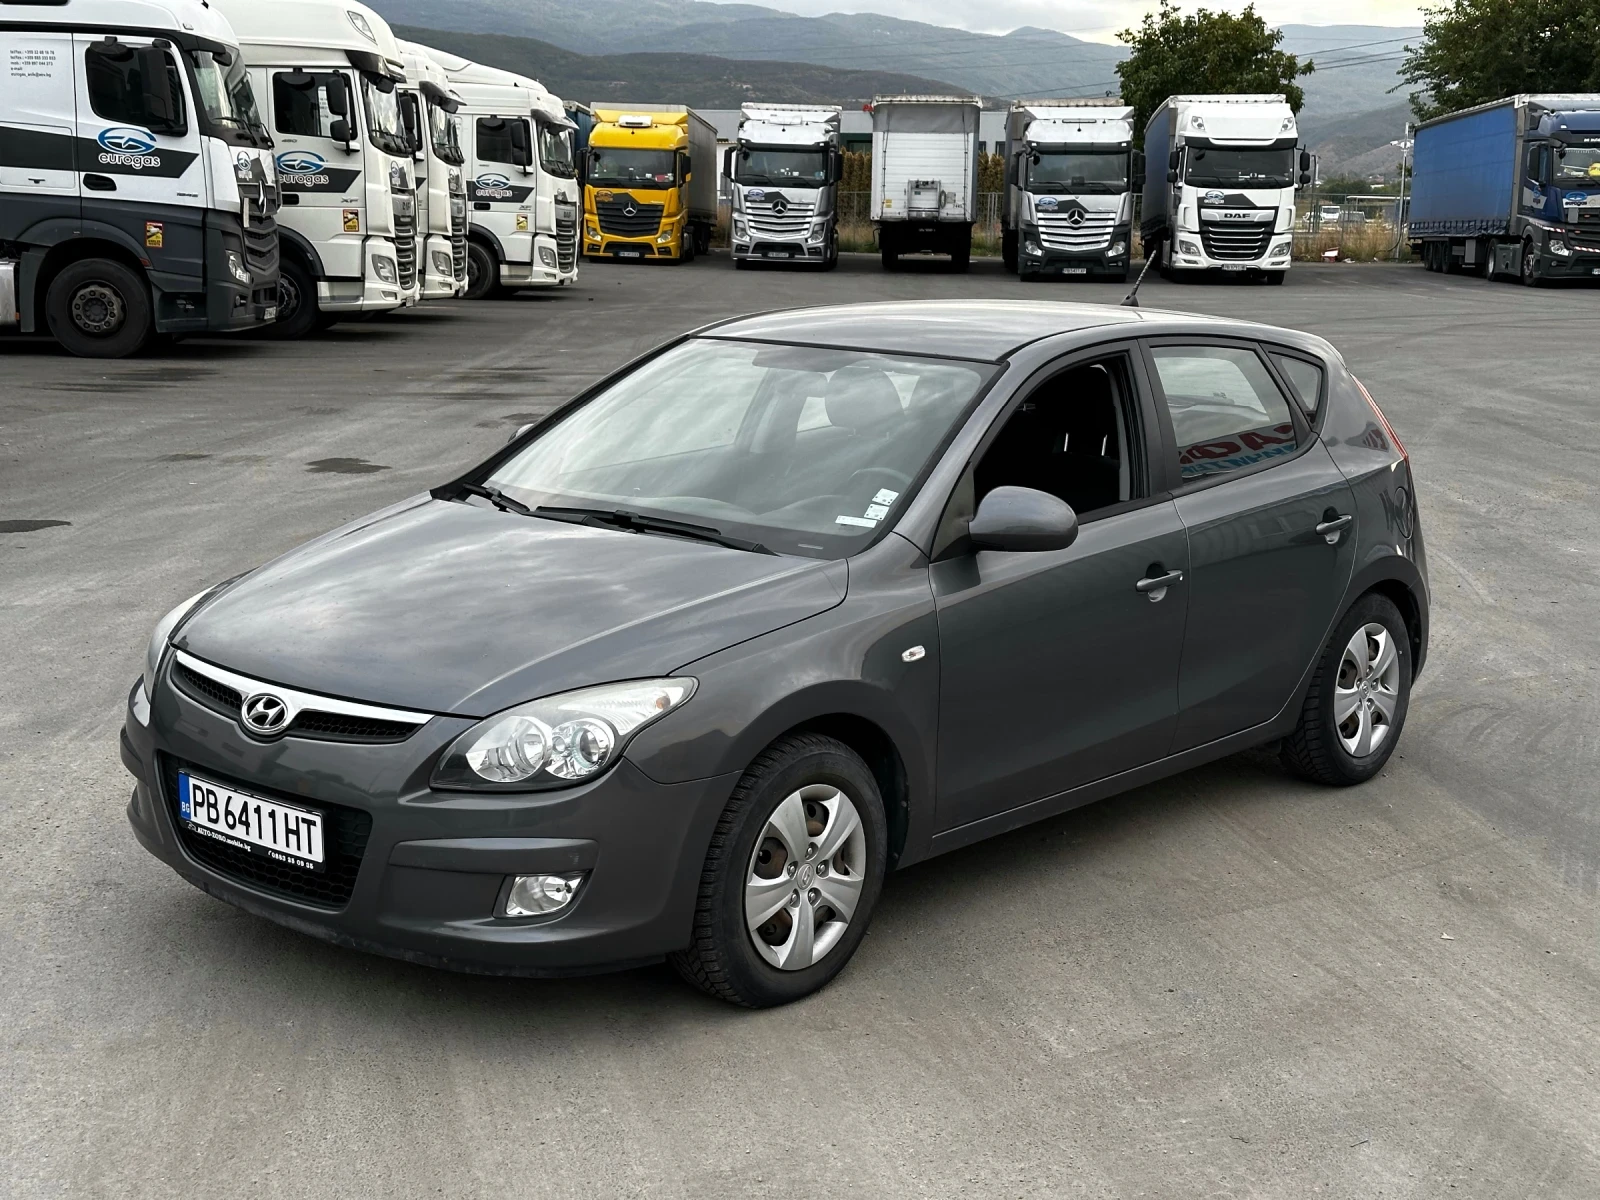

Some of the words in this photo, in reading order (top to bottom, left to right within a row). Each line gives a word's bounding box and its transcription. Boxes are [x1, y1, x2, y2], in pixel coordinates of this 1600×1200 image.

[98, 152, 161, 170] eurogas
[279, 174, 330, 187] eurogas
[181, 801, 190, 813] BG
